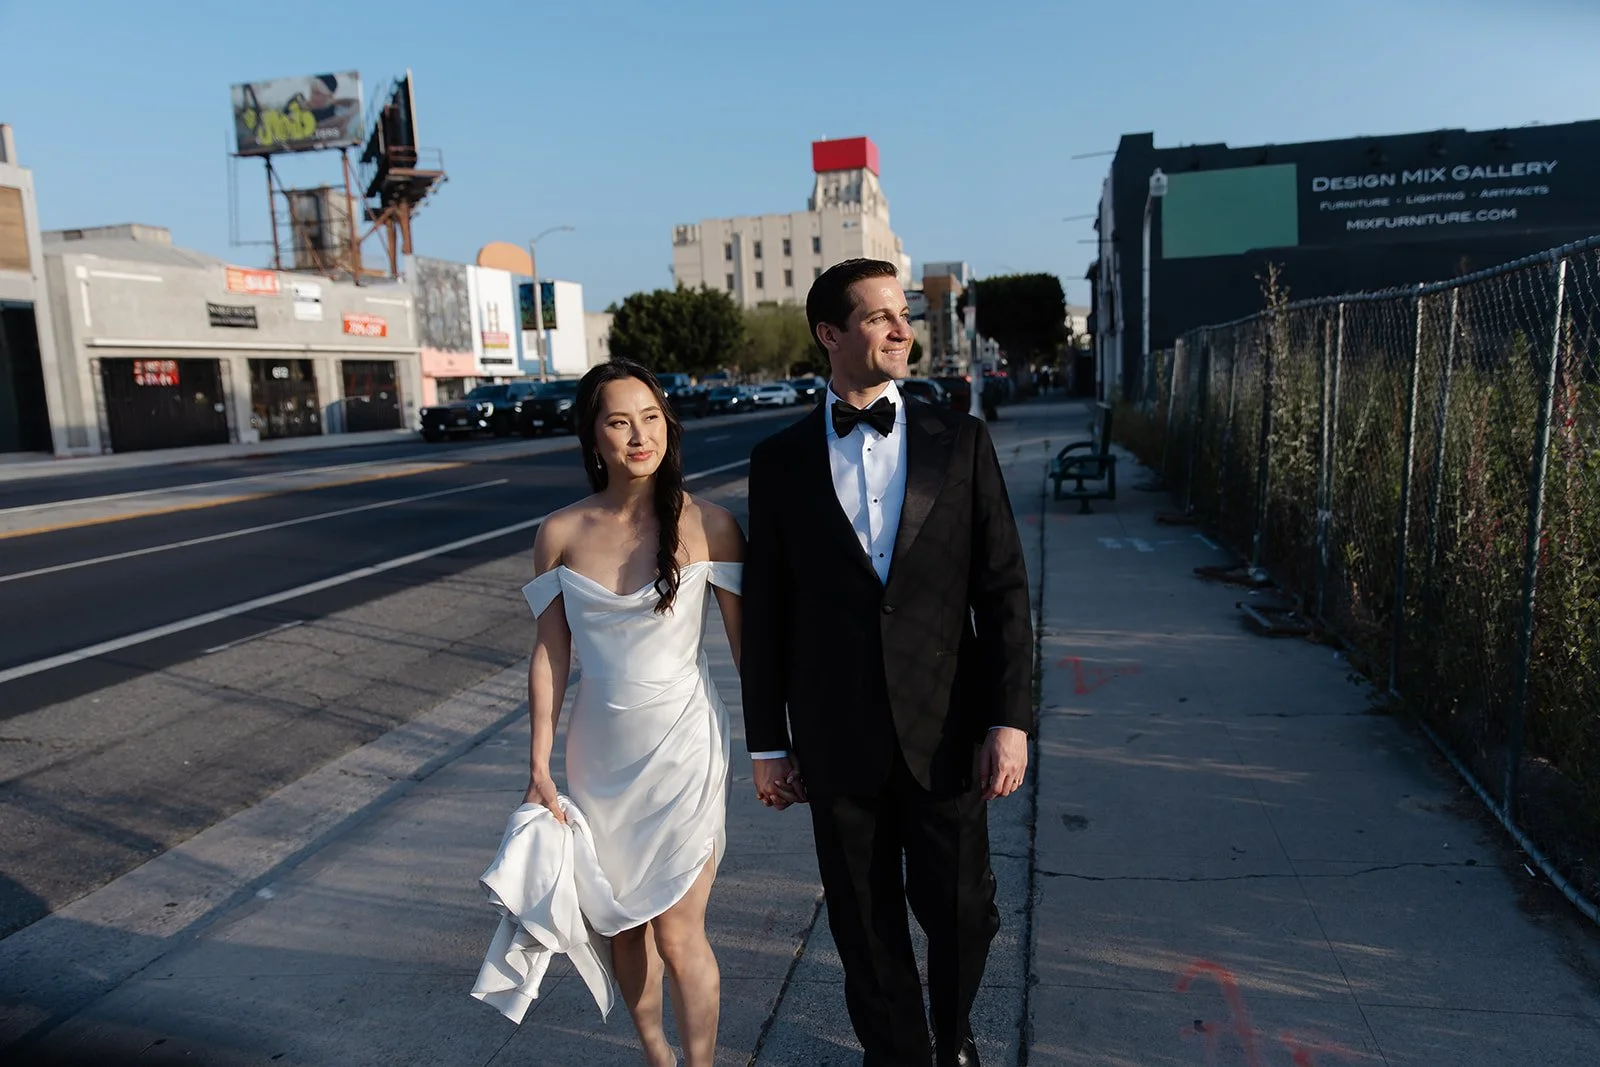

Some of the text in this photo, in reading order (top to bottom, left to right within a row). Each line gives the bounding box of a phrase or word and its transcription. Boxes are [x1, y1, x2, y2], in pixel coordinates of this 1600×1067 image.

[1312, 160, 1558, 192] DESIGN MIX GALLERY
[1320, 184, 1550, 211] FURNITURE LIGHTING ARTIFACTS
[1346, 208, 1517, 230] MIXFURNITURE.COM
